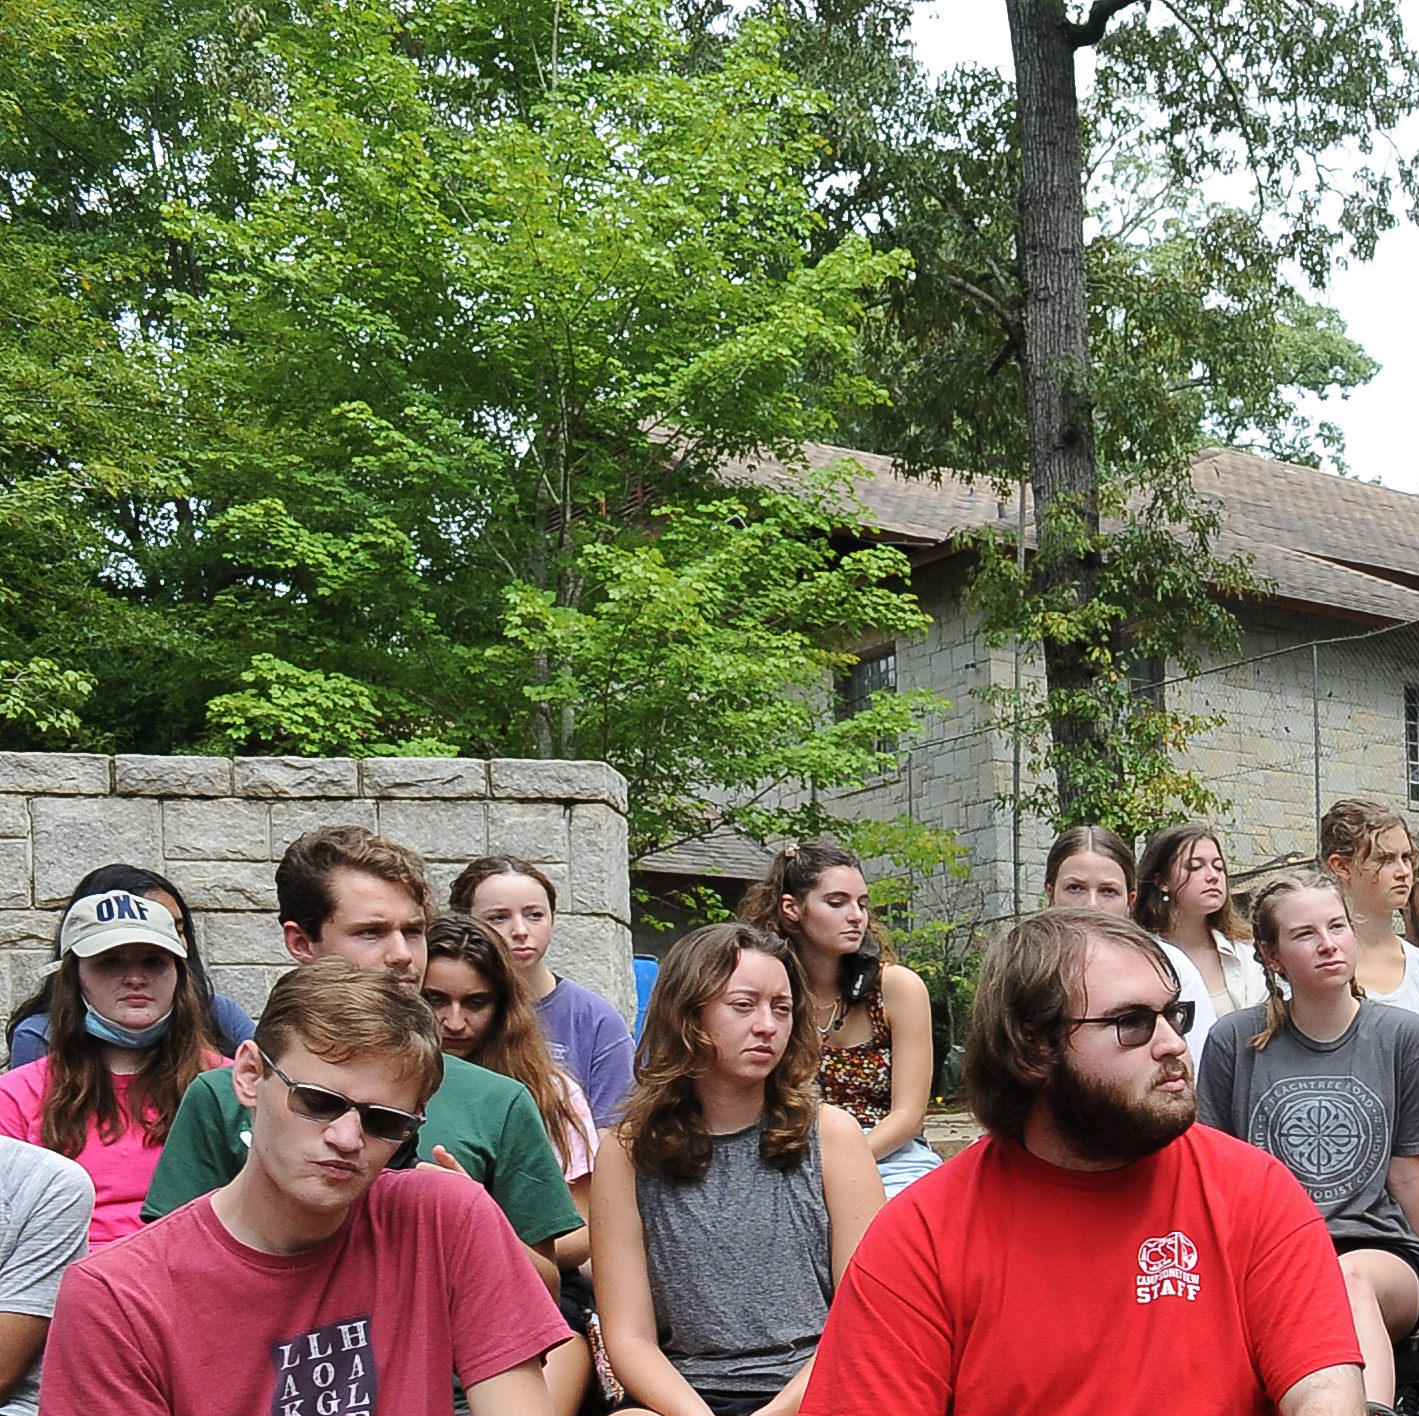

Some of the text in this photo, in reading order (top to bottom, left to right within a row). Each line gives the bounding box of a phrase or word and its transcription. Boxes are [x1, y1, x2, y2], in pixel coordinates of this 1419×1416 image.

[1268, 1081, 1374, 1108] PEACHTREE ROAD
[1136, 1279, 1201, 1304] STAFF
